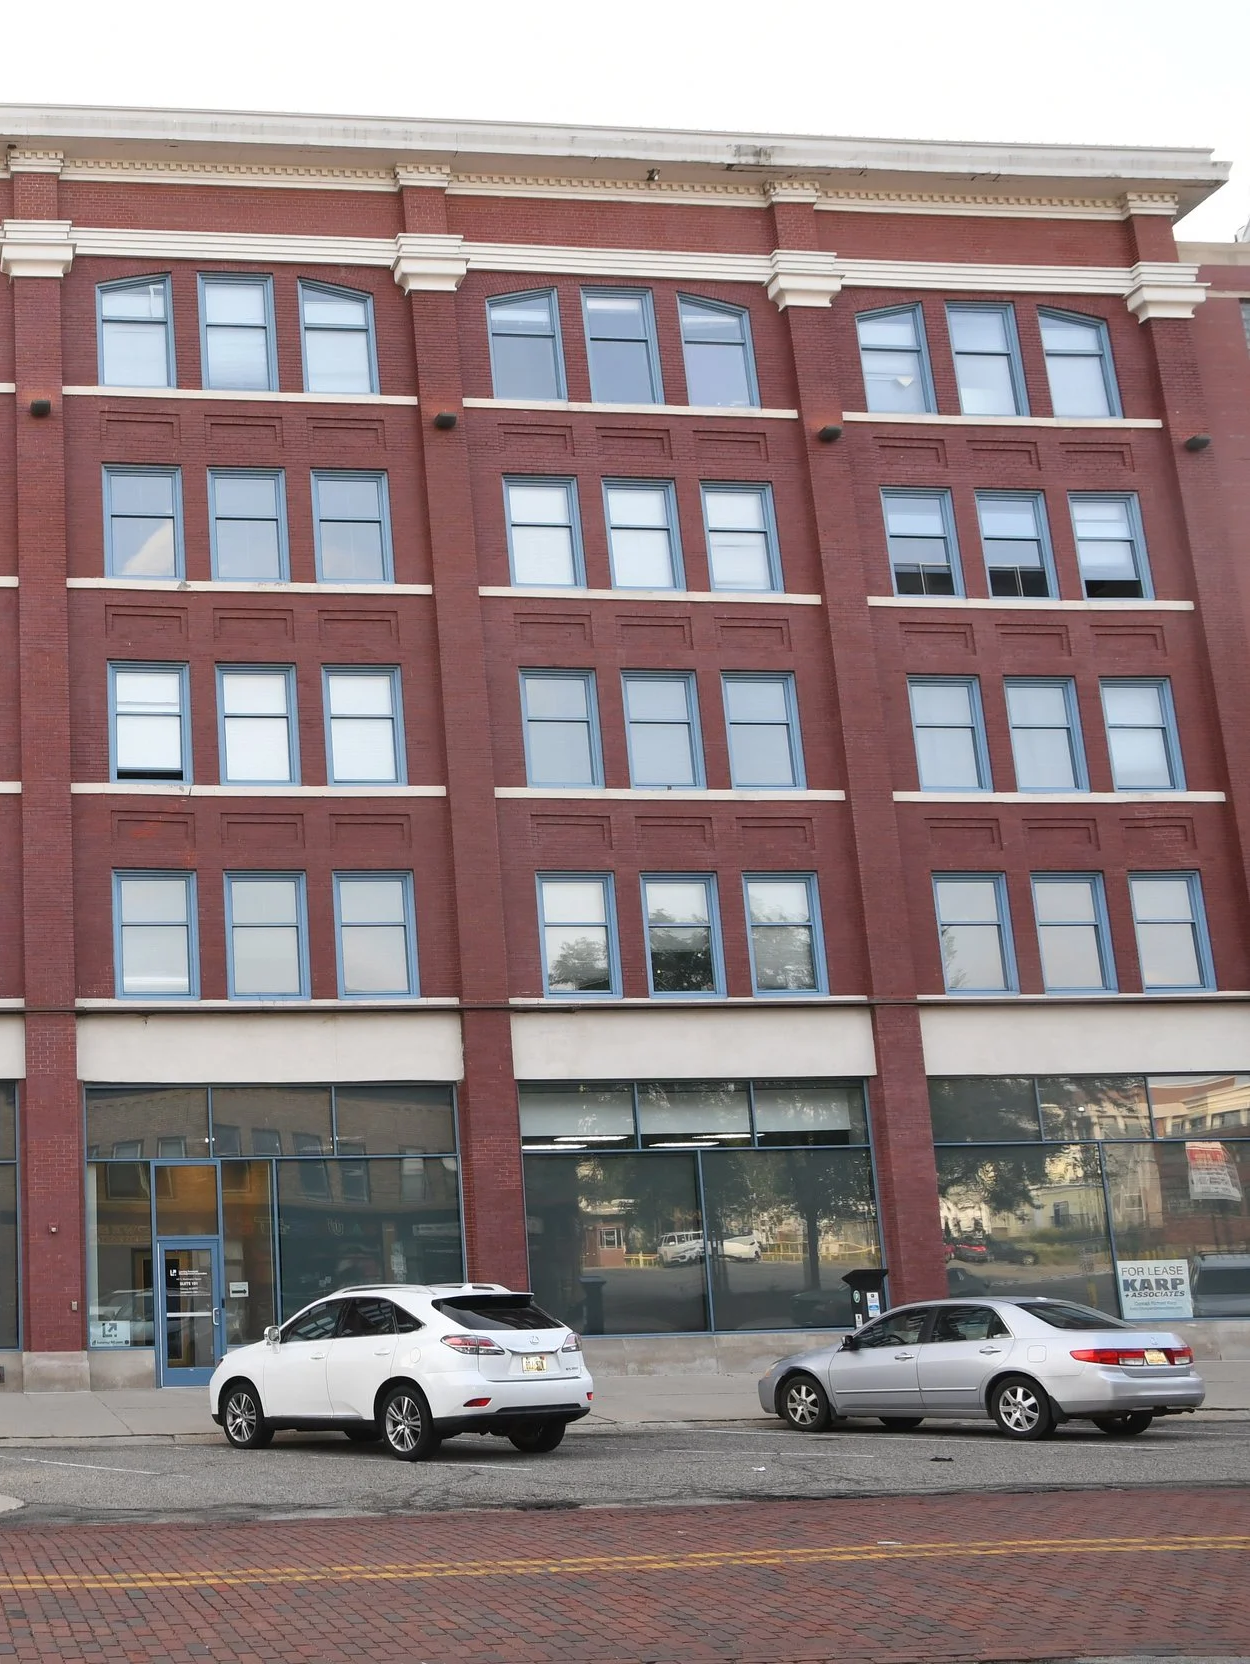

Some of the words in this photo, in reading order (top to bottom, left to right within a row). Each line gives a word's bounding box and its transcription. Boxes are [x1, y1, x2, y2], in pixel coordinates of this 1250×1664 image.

[1121, 1267, 1145, 1276] FOR
[1148, 1266, 1183, 1275] LEASE
[1123, 1278, 1185, 1292] KARP
